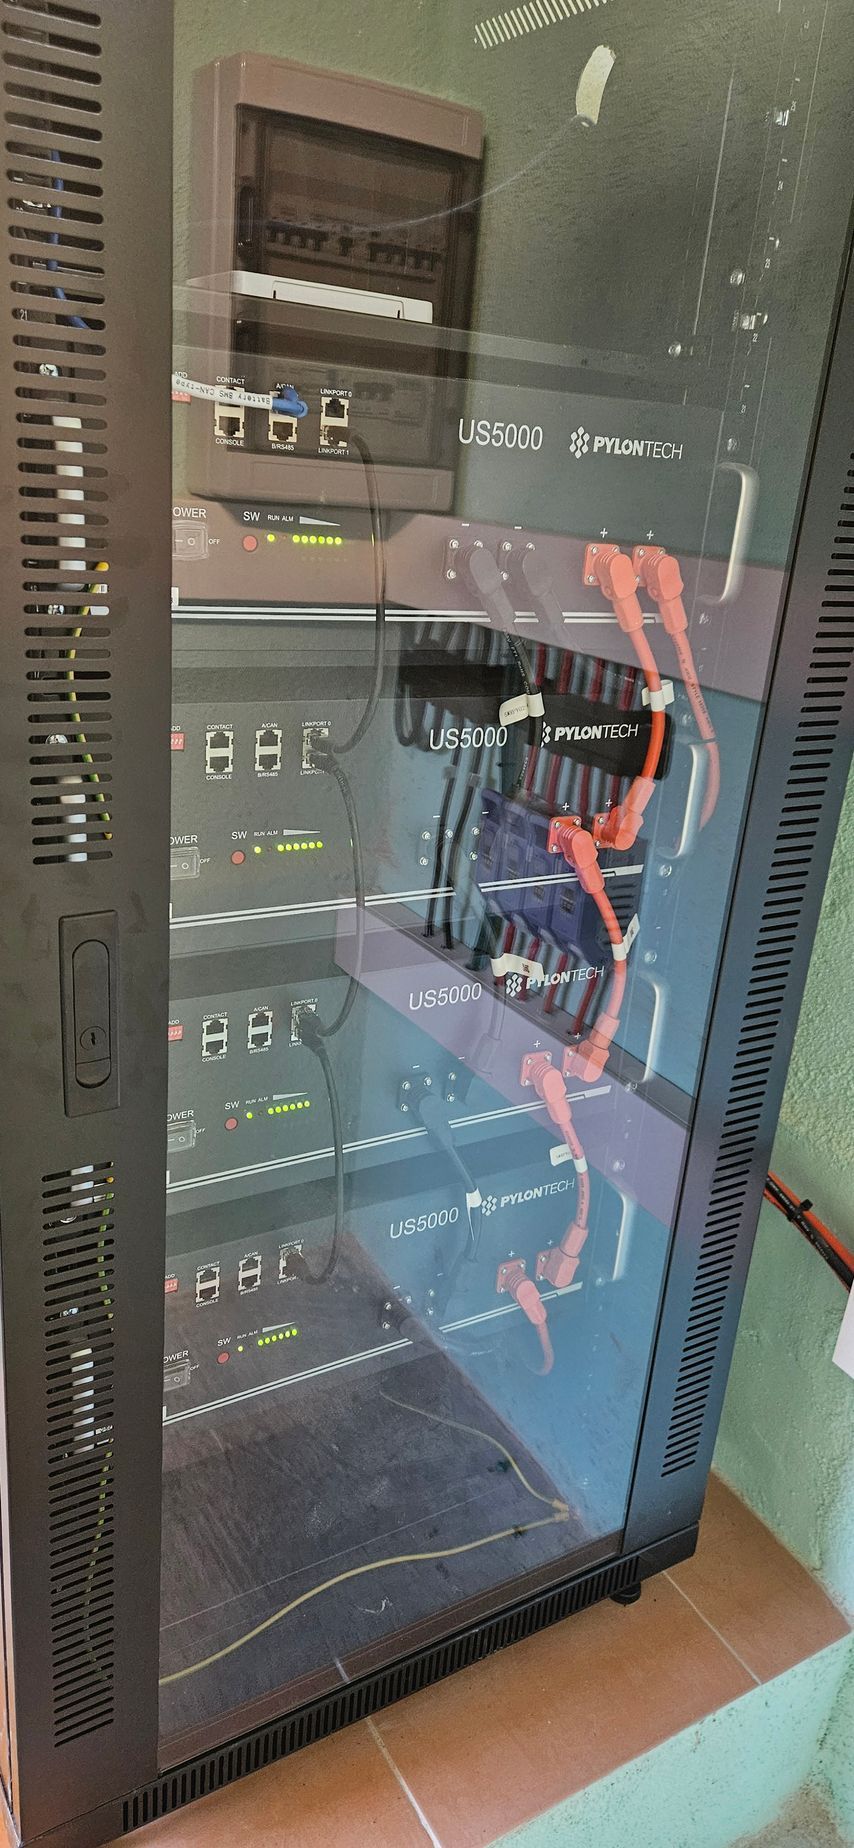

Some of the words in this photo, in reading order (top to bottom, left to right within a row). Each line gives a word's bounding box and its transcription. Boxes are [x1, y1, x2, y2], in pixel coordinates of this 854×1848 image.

[216, 376, 245, 385] CONTACT
[219, 391, 234, 400] BMS
[320, 388, 348, 397] LINKPORT
[238, 392, 271, 405] Battery
[458, 418, 544, 451] US5000
[215, 438, 244, 446] CONSOLE
[272, 443, 295, 451] B/RS485
[593, 435, 684, 460] PYLONTECH
[173, 507, 207, 519] OWER
[243, 511, 261, 522] SW
[554, 723, 639, 742] PYLONTECH
[429, 726, 508, 751] US5000
[170, 834, 198, 845] OWER
[231, 831, 248, 840] SW
[408, 982, 483, 1011] US5000
[203, 1012, 228, 1020] CONTACT
[202, 1054, 227, 1063] CONSOLE
[224, 1100, 240, 1110] SW
[167, 1109, 194, 1121] OWER
[500, 1178, 576, 1208] PYLONTECH
[389, 1207, 460, 1240] US5000
[197, 1261, 220, 1271] CONTACT
[195, 1298, 219, 1308] CONSOLE
[217, 1336, 232, 1347] SW
[163, 1350, 189, 1364] OWER
